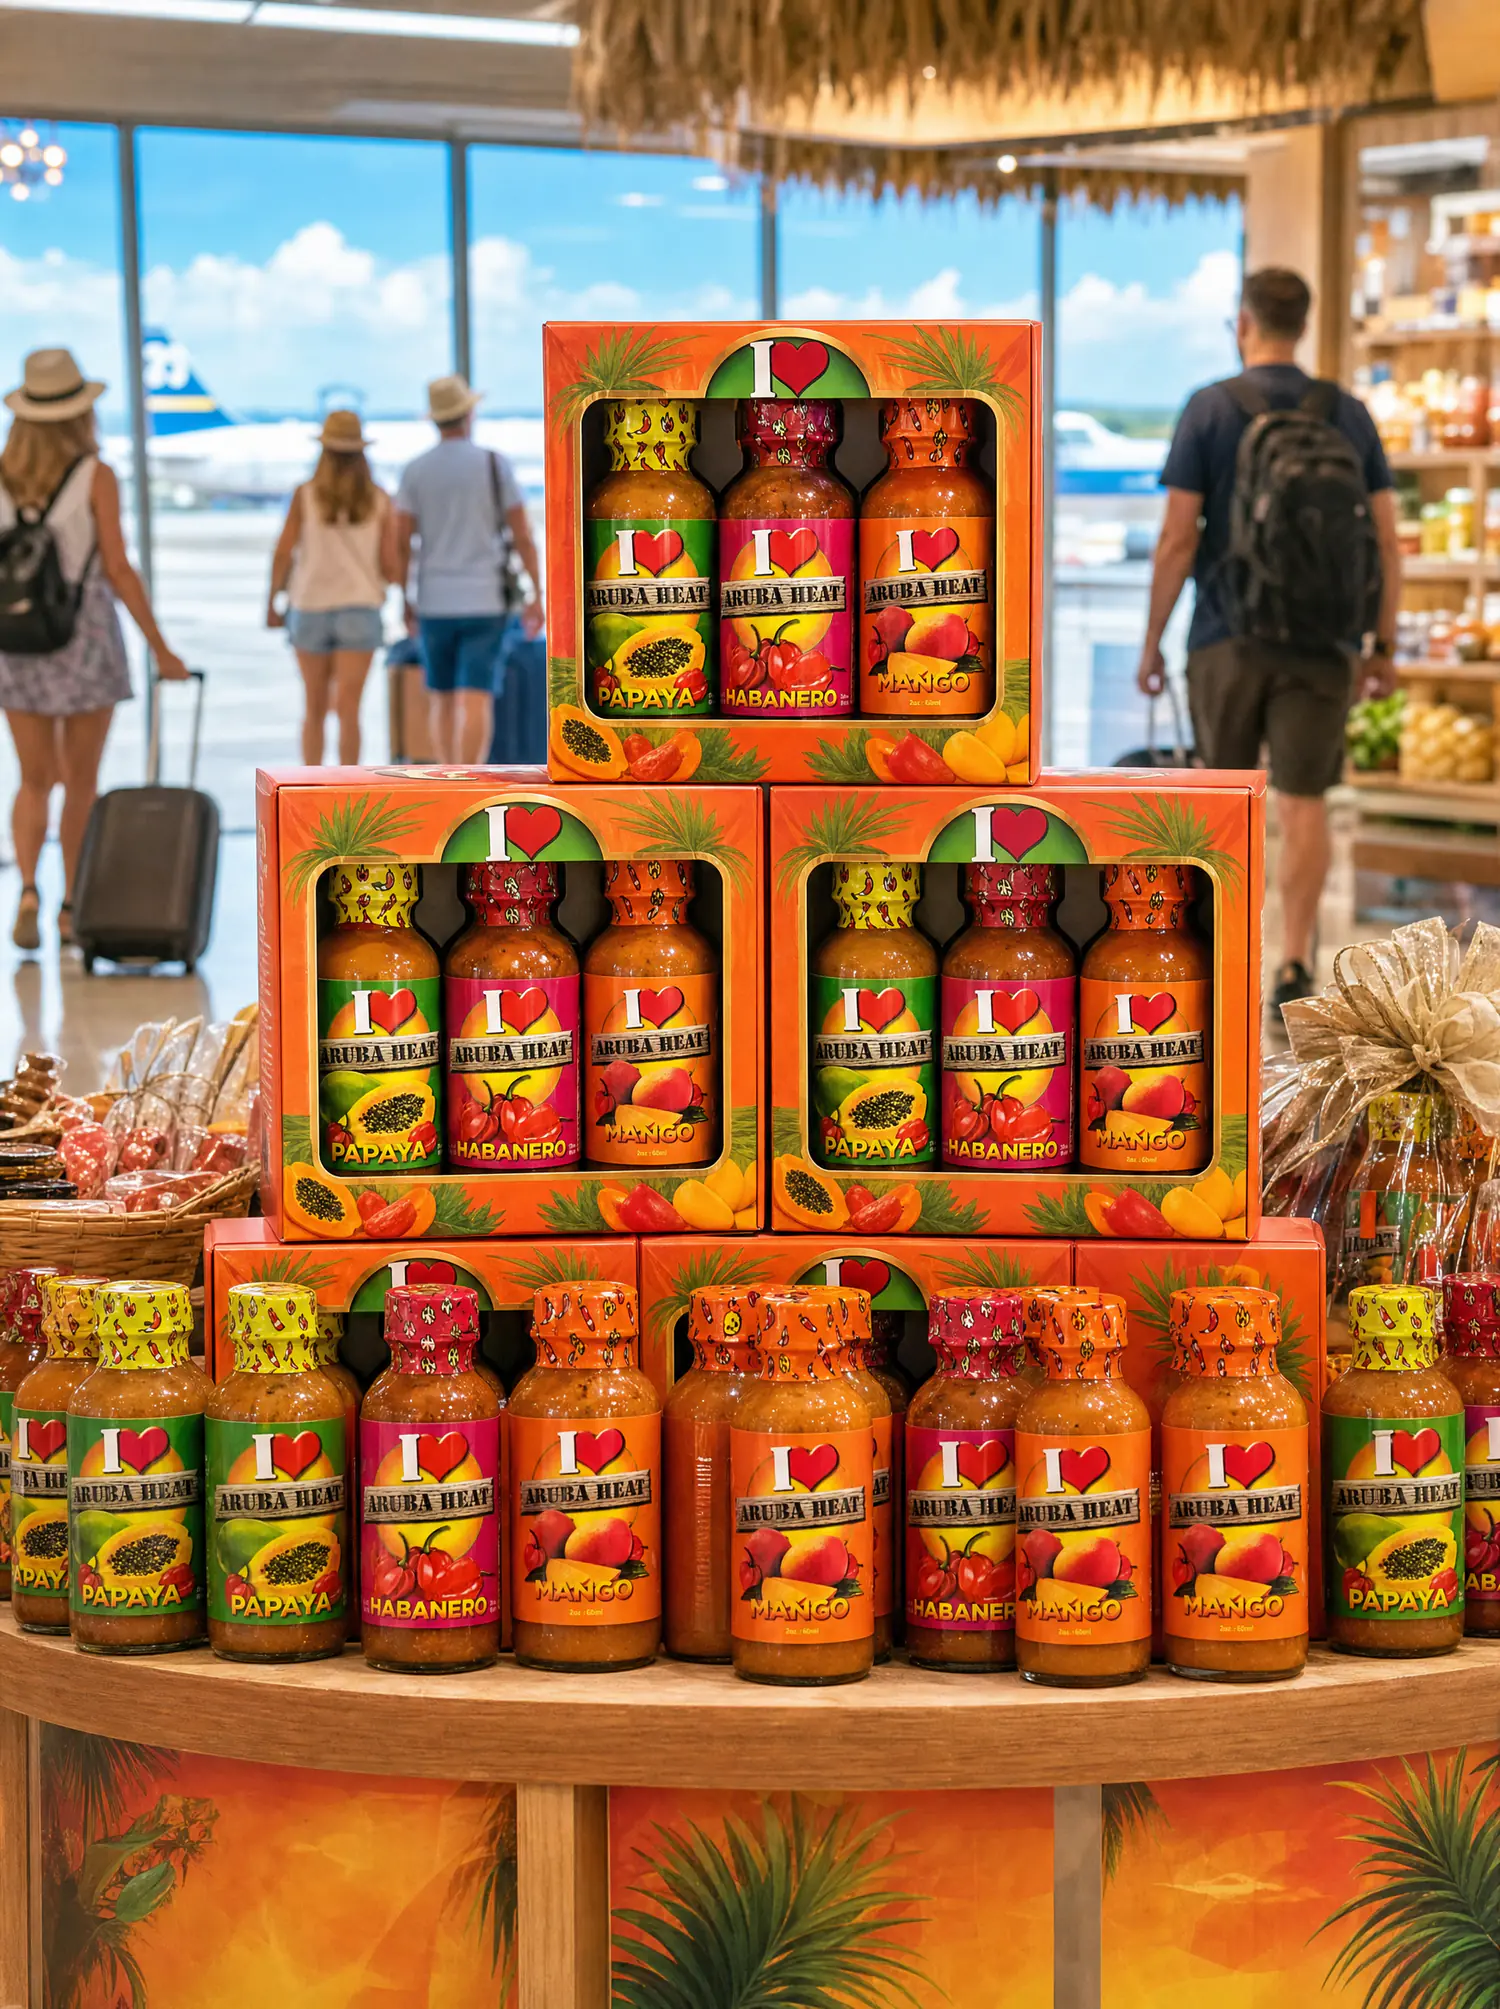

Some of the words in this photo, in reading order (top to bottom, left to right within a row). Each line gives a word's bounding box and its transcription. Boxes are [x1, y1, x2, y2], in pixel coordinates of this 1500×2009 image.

[750, 341, 775, 398] I
[616, 529, 639, 575] I
[752, 529, 774, 576] I
[895, 530, 917, 572] I
[588, 586, 650, 606] ARUBA
[656, 585, 707, 604] HEAT
[724, 586, 784, 608] ARUBA
[791, 585, 841, 603] HEAT
[870, 580, 927, 602] ARUBA
[933, 577, 981, 595] HEAT
[877, 672, 971, 694] MANGO
[598, 687, 696, 709] PAPAYA
[726, 688, 838, 709] HABANERO
[485, 806, 511, 861] I
[972, 807, 996, 862] I
[351, 990, 375, 1035] I
[483, 989, 505, 1034] I
[623, 988, 645, 1029] I
[841, 988, 863, 1032] I
[974, 989, 997, 1034] I
[1114, 993, 1135, 1034] I
[320, 1045, 385, 1065] ARUBA
[391, 1040, 436, 1062] HEAT
[455, 1044, 516, 1063] ARUBA
[522, 1040, 569, 1061] HEAT
[596, 1037, 654, 1056] ARUBA
[659, 1031, 706, 1051] HEAT
[815, 1042, 872, 1060] ARUBA
[879, 1038, 928, 1059] HEAT
[947, 1044, 1007, 1062] ARUBA
[1012, 1040, 1061, 1060] HEAT
[1087, 1043, 1145, 1060] ARUBA
[1150, 1038, 1198, 1058] HEAT
[604, 1122, 695, 1144] MANGO
[1095, 1128, 1187, 1151] MANGO
[331, 1140, 428, 1164] PAPAYA
[456, 1139, 567, 1161] HABANERO
[824, 1136, 917, 1160] PAPAYA
[948, 1138, 1058, 1161] HABANERO
[18, 1418, 31, 1459] I
[100, 1428, 123, 1473] I
[252, 1433, 277, 1480] I
[399, 1433, 423, 1481] I
[557, 1430, 580, 1475] I
[939, 1440, 962, 1488] I
[1372, 1429, 1397, 1476] I
[770, 1446, 794, 1491] I
[1042, 1448, 1066, 1493] I
[1205, 1443, 1230, 1489] I
[74, 1484, 134, 1503] ARUBA
[141, 1478, 194, 1500] HEAT
[219, 1491, 289, 1512] ARUBA
[295, 1485, 342, 1508] HEAT
[368, 1493, 433, 1513] ARUBA
[440, 1487, 489, 1510] HEAT
[527, 1484, 590, 1505] ARUBA
[596, 1478, 645, 1500] HEAT
[1337, 1487, 1407, 1507] ARUBA
[1413, 1481, 1460, 1503] HEAT
[740, 1501, 806, 1522] ARUBA
[812, 1496, 860, 1518] HEAT
[911, 1498, 973, 1517] ARUBA
[1018, 1503, 1076, 1523] ARUBA
[1082, 1497, 1133, 1519] HEAT
[1174, 1498, 1240, 1518] ARUBA
[1247, 1493, 1296, 1515] HEAT
[12, 1565, 69, 1589] APAY
[82, 1584, 183, 1609] PAPAYA
[534, 1578, 635, 1603] MANGO
[1349, 1588, 1450, 1613] PAPAYA
[231, 1592, 333, 1618] PAPAYA
[370, 1596, 488, 1620] HABANERO
[750, 1597, 850, 1621] MANGO
[913, 1598, 1016, 1623] HABANER
[1025, 1598, 1123, 1623] MANGO
[1183, 1593, 1285, 1619] MANGO
